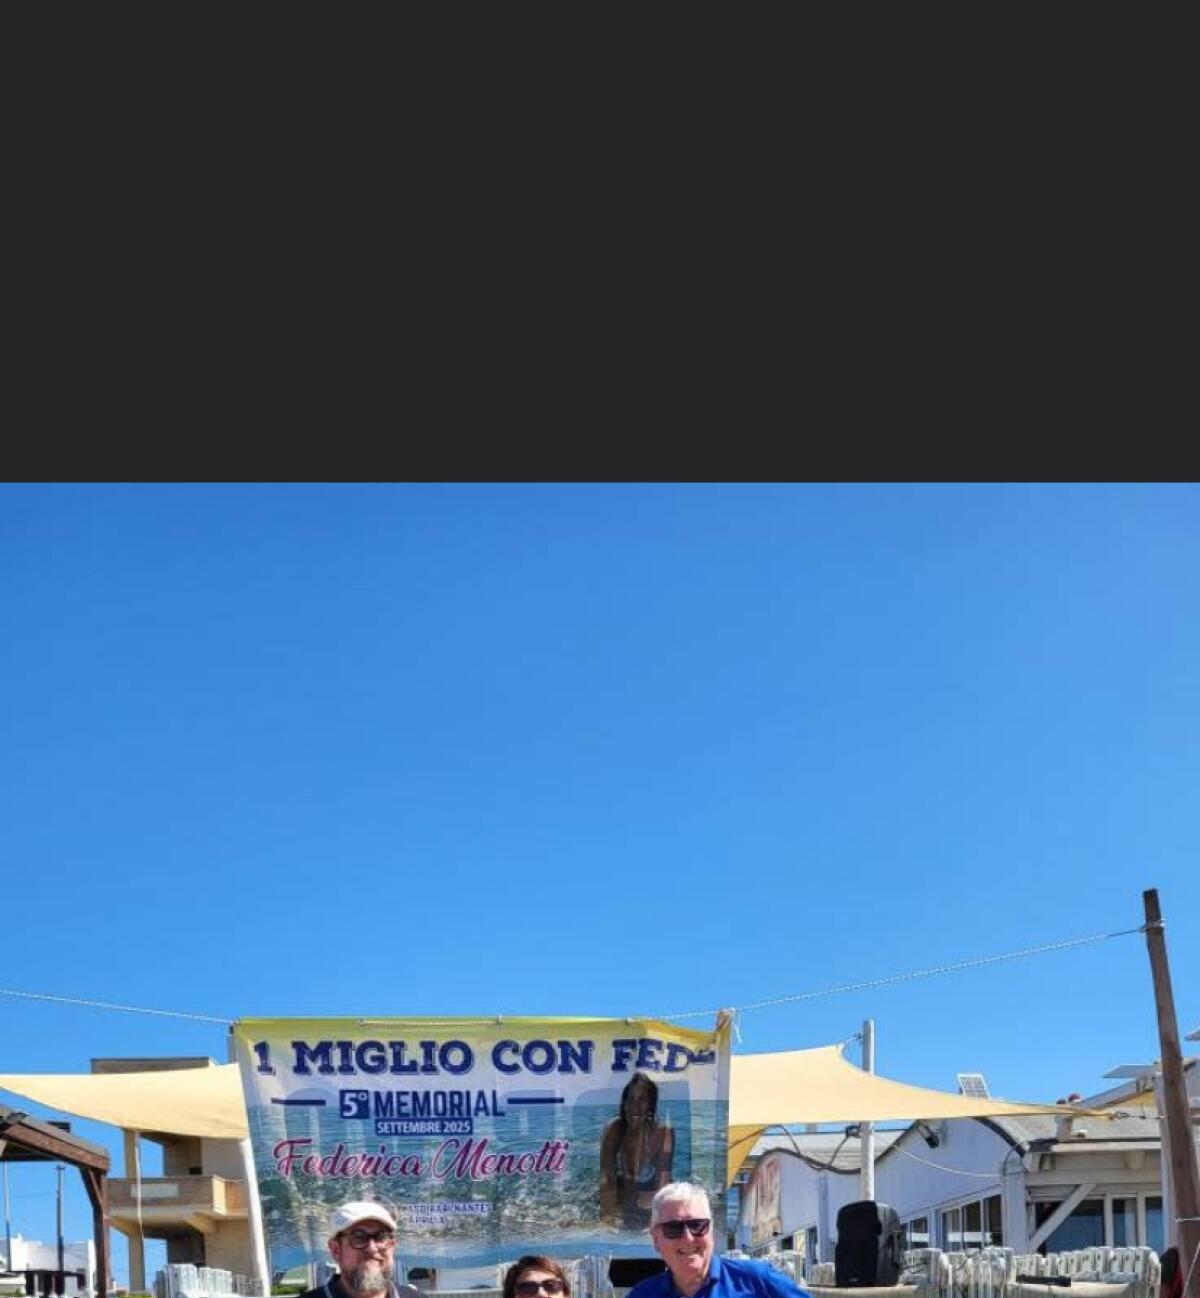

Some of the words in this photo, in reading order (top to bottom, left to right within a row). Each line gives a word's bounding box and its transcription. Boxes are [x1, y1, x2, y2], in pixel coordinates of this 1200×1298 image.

[254, 1041, 276, 1075] 1
[292, 1040, 473, 1075] MIGLIO
[492, 1039, 593, 1076] CON
[375, 1090, 505, 1119] MEMORIAL
[377, 1120, 441, 1133] SETTEMBRE
[442, 1120, 472, 1132] 2025
[273, 1138, 422, 1179] Federica
[431, 1137, 570, 1181] Menotti
